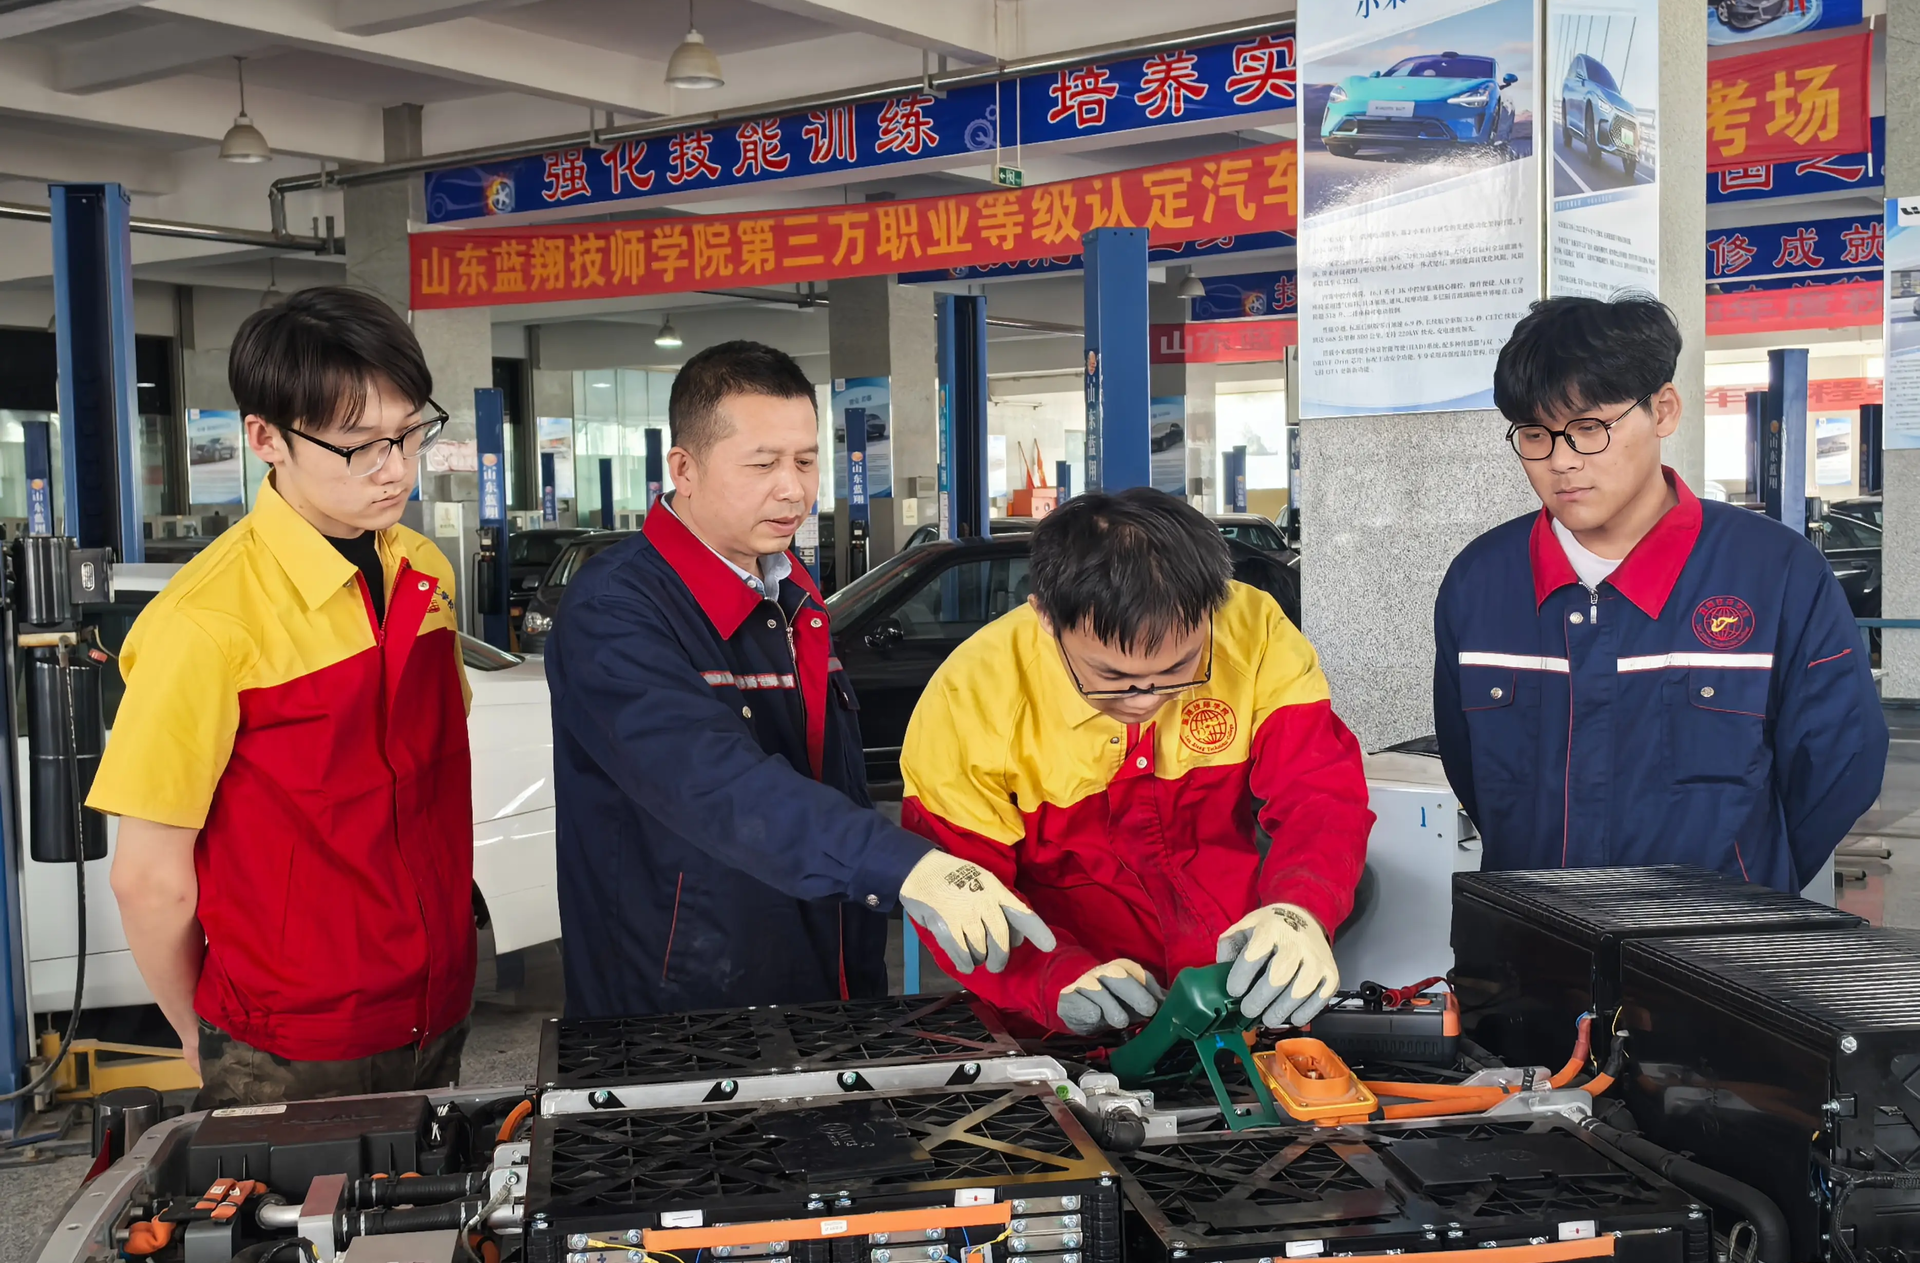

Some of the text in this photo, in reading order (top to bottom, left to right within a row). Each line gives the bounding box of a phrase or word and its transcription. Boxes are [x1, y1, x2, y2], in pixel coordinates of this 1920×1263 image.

[541, 35, 1296, 202] 强化技能训练 培养实
[1707, 64, 1840, 158] 考场
[420, 147, 1298, 296] 山东蓝翔技师学院第三方职业等级认定汽车
[1708, 222, 1884, 276] 修成就
[852, 464, 864, 504] 山东蓝翔
